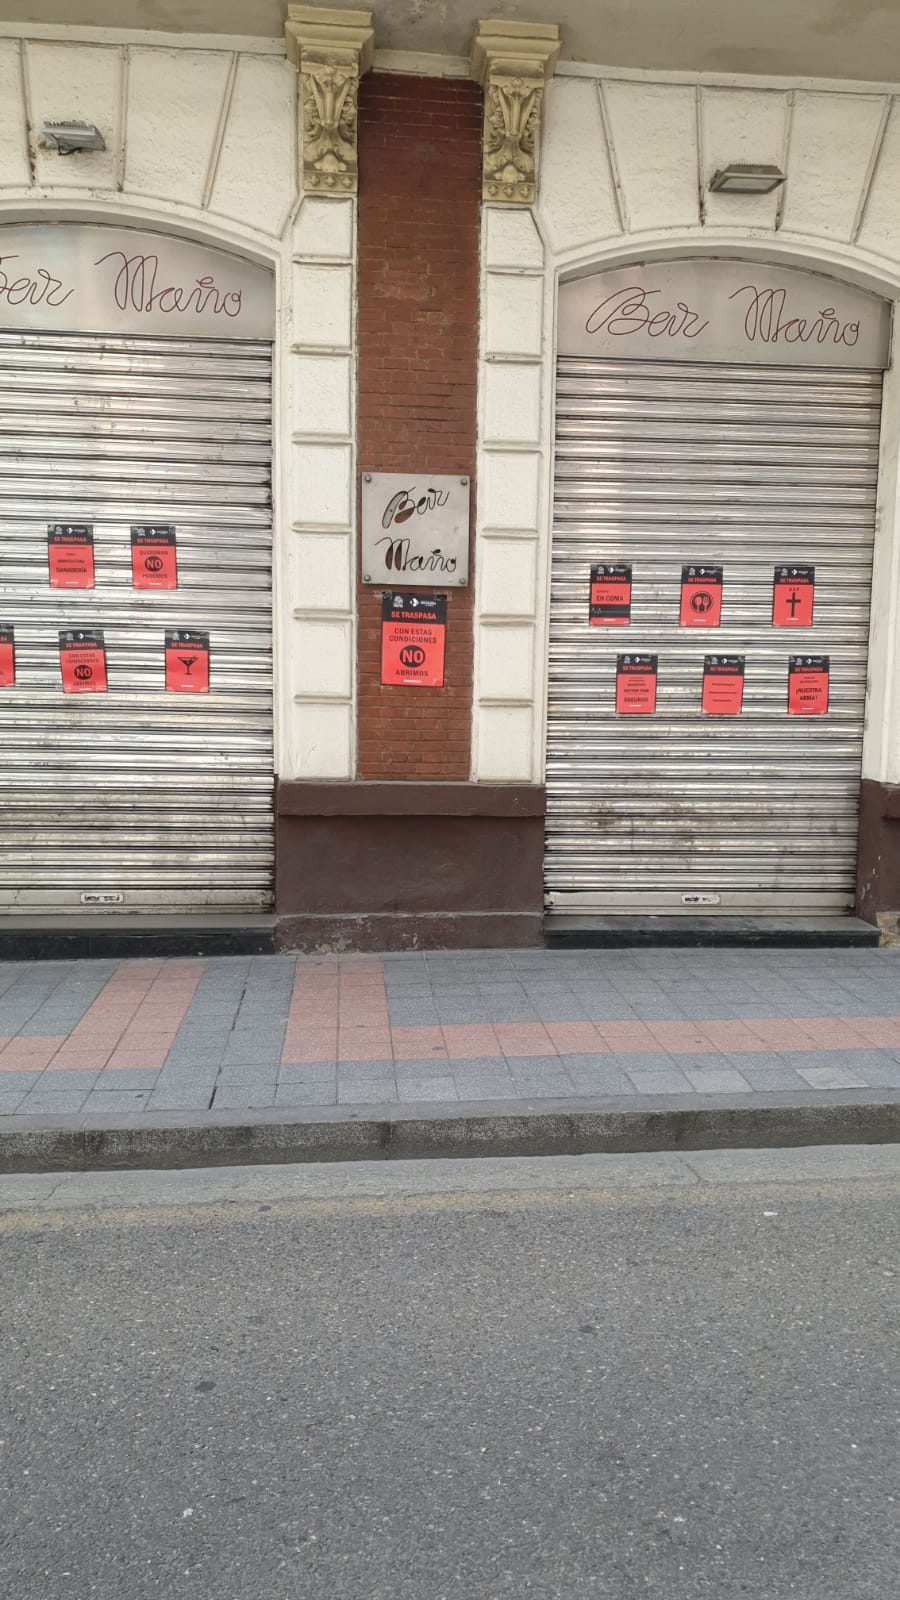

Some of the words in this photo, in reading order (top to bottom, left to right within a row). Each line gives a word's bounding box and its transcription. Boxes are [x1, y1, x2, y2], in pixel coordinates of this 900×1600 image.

[0, 254, 75, 306] ar
[586, 286, 710, 338] Bar
[381, 486, 450, 529] Bar
[146, 559, 162, 569] NO
[391, 610, 399, 618] SE
[401, 611, 437, 620] TRASPASA
[411, 628, 432, 636] ESTAS
[389, 635, 437, 644] CONDICIONES
[402, 649, 425, 664] NO
[76, 667, 91, 677] NO
[395, 669, 429, 677] ABRIMOS
